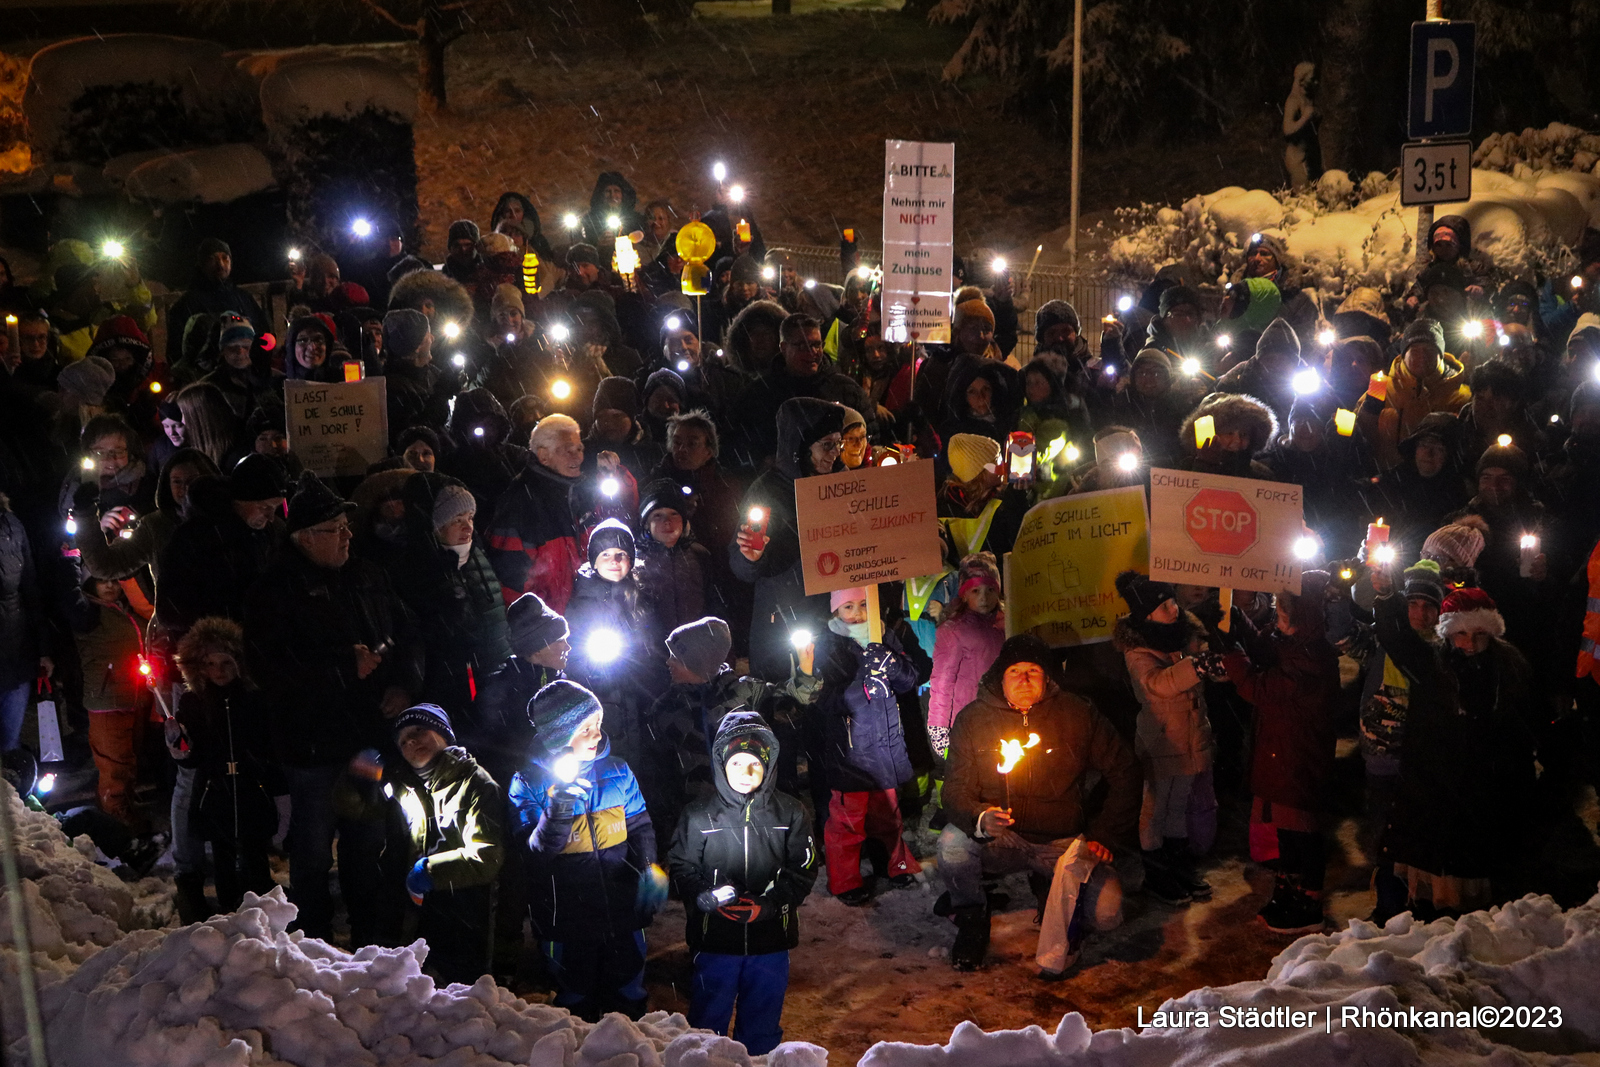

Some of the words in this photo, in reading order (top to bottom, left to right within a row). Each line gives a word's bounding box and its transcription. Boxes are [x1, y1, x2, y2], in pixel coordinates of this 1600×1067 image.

[1424, 37, 1460, 123] P
[900, 165, 937, 177] BITTE
[891, 197, 925, 208] Nehmt
[929, 199, 946, 208] mir
[899, 213, 938, 225] NICHT
[904, 249, 930, 258] mein
[891, 263, 943, 276] Zuhause
[294, 390, 329, 404] LASST
[304, 407, 320, 420] DIE
[330, 405, 365, 418] SCHULE
[298, 425, 312, 437] IM
[321, 423, 348, 436] DORF
[1151, 474, 1200, 489] SCHULE
[818, 480, 867, 501] UNSERE
[848, 495, 900, 514] SCHULE
[1053, 506, 1101, 526] SCHULE
[1189, 505, 1252, 534] STOP
[806, 522, 858, 542] UNSERE
[870, 511, 927, 531] ZUKUNFT
[1020, 532, 1058, 554] STRAHLT
[1068, 527, 1082, 541] IM
[1090, 521, 1132, 539] LICHT
[844, 545, 878, 558] STOPPT
[1153, 556, 1211, 574] BILDUNG
[1220, 565, 1233, 578] IM
[1240, 567, 1269, 581] ORT
[1024, 571, 1041, 588] MIT
[1051, 621, 1075, 634] IHR
[1081, 616, 1107, 630] DAS
